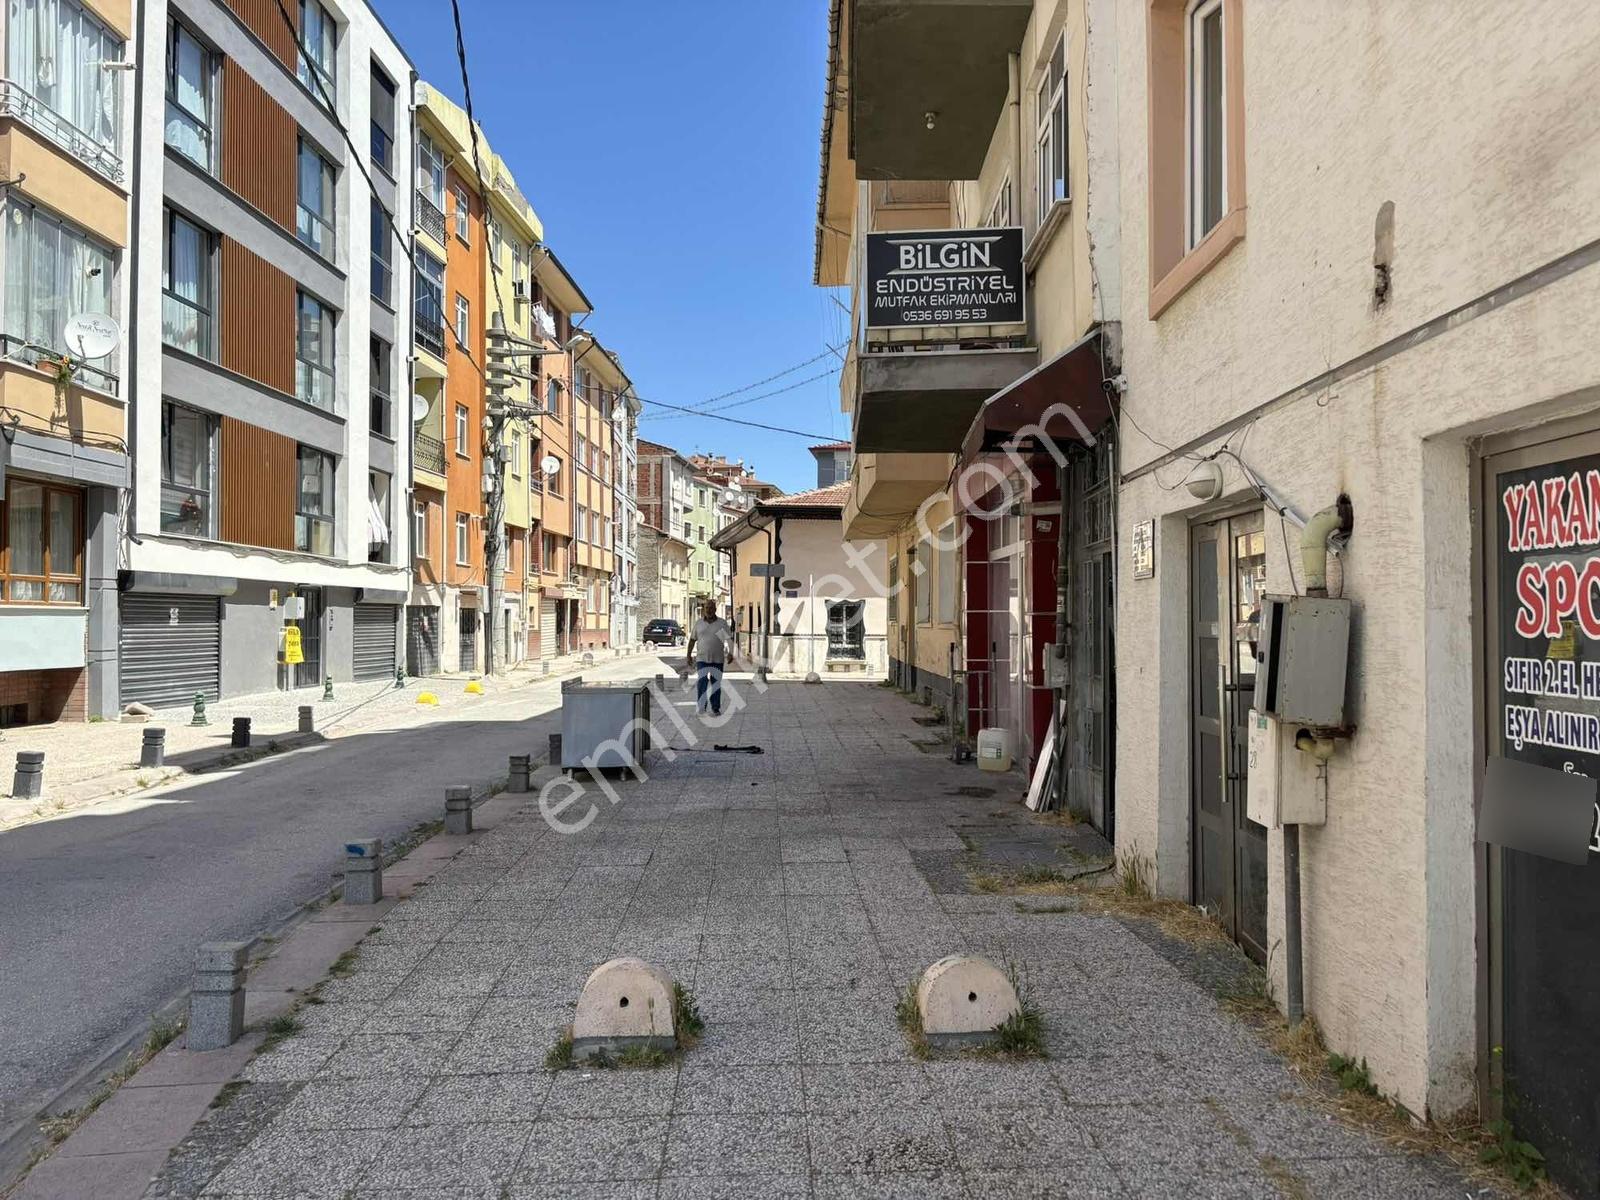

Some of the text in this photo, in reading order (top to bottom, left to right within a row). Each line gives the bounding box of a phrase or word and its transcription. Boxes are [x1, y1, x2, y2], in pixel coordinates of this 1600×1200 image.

[874, 292, 1017, 308] MUTFAK EKİPMANLARI
[903, 308, 988, 322] 0536 691 95 53
[1505, 657, 1543, 695] SIFIR
[1544, 659, 1580, 698] 2.EL
[1505, 705, 1542, 750] EŞYA
